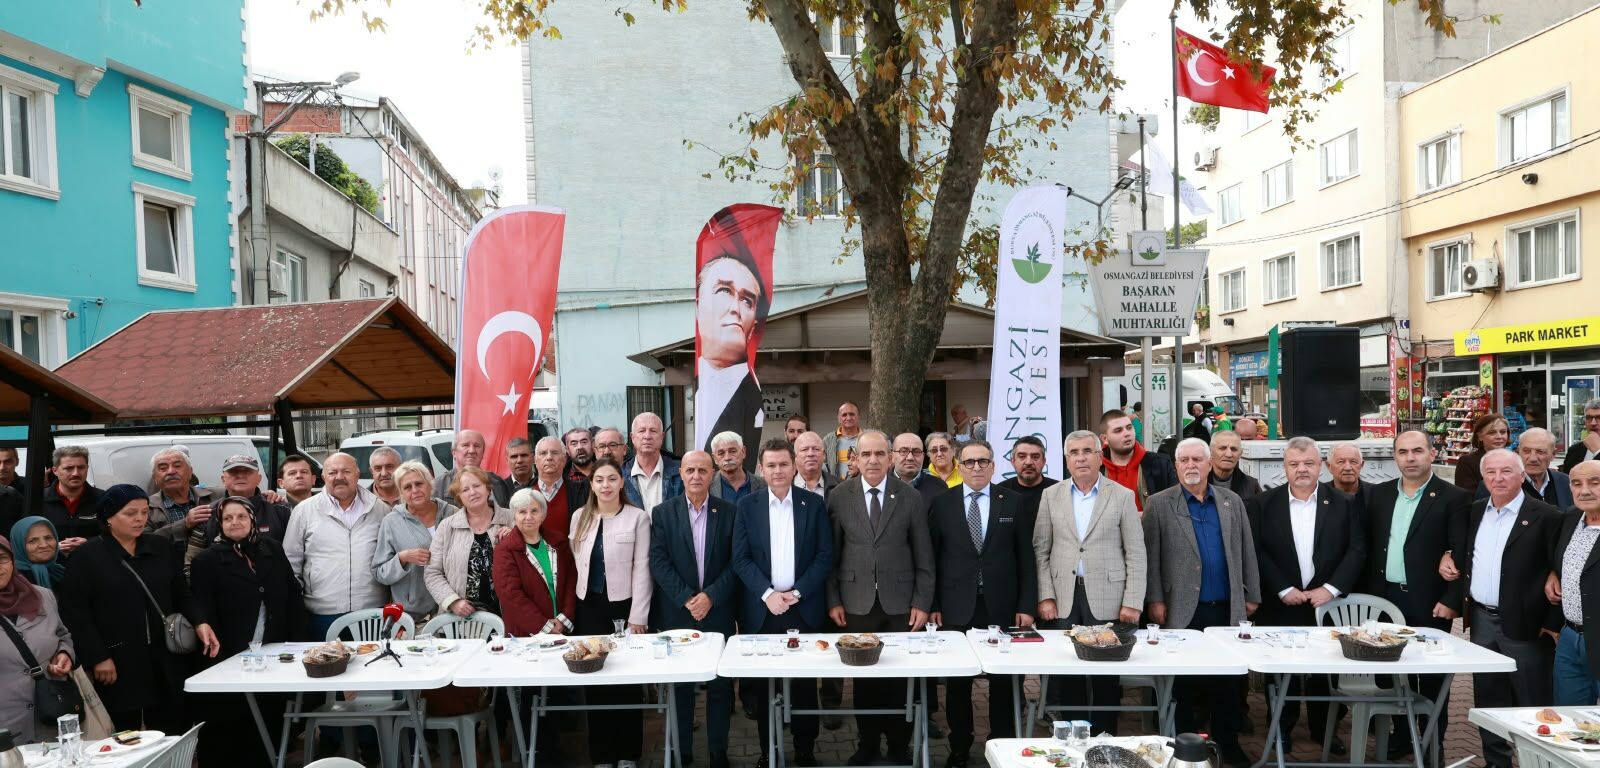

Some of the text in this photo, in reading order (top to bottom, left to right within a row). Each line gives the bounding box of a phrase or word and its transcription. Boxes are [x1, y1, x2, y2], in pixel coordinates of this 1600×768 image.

[1103, 270, 1194, 280] OSMANGAZİ BELEDİYESİ
[1122, 285, 1176, 298] BAŞARAN
[1120, 301, 1177, 313] MAHALLE
[1112, 315, 1186, 330] MUHTARLIĞI
[1505, 325, 1588, 344] PARK MARKET
[1151, 375, 1166, 383] 44
